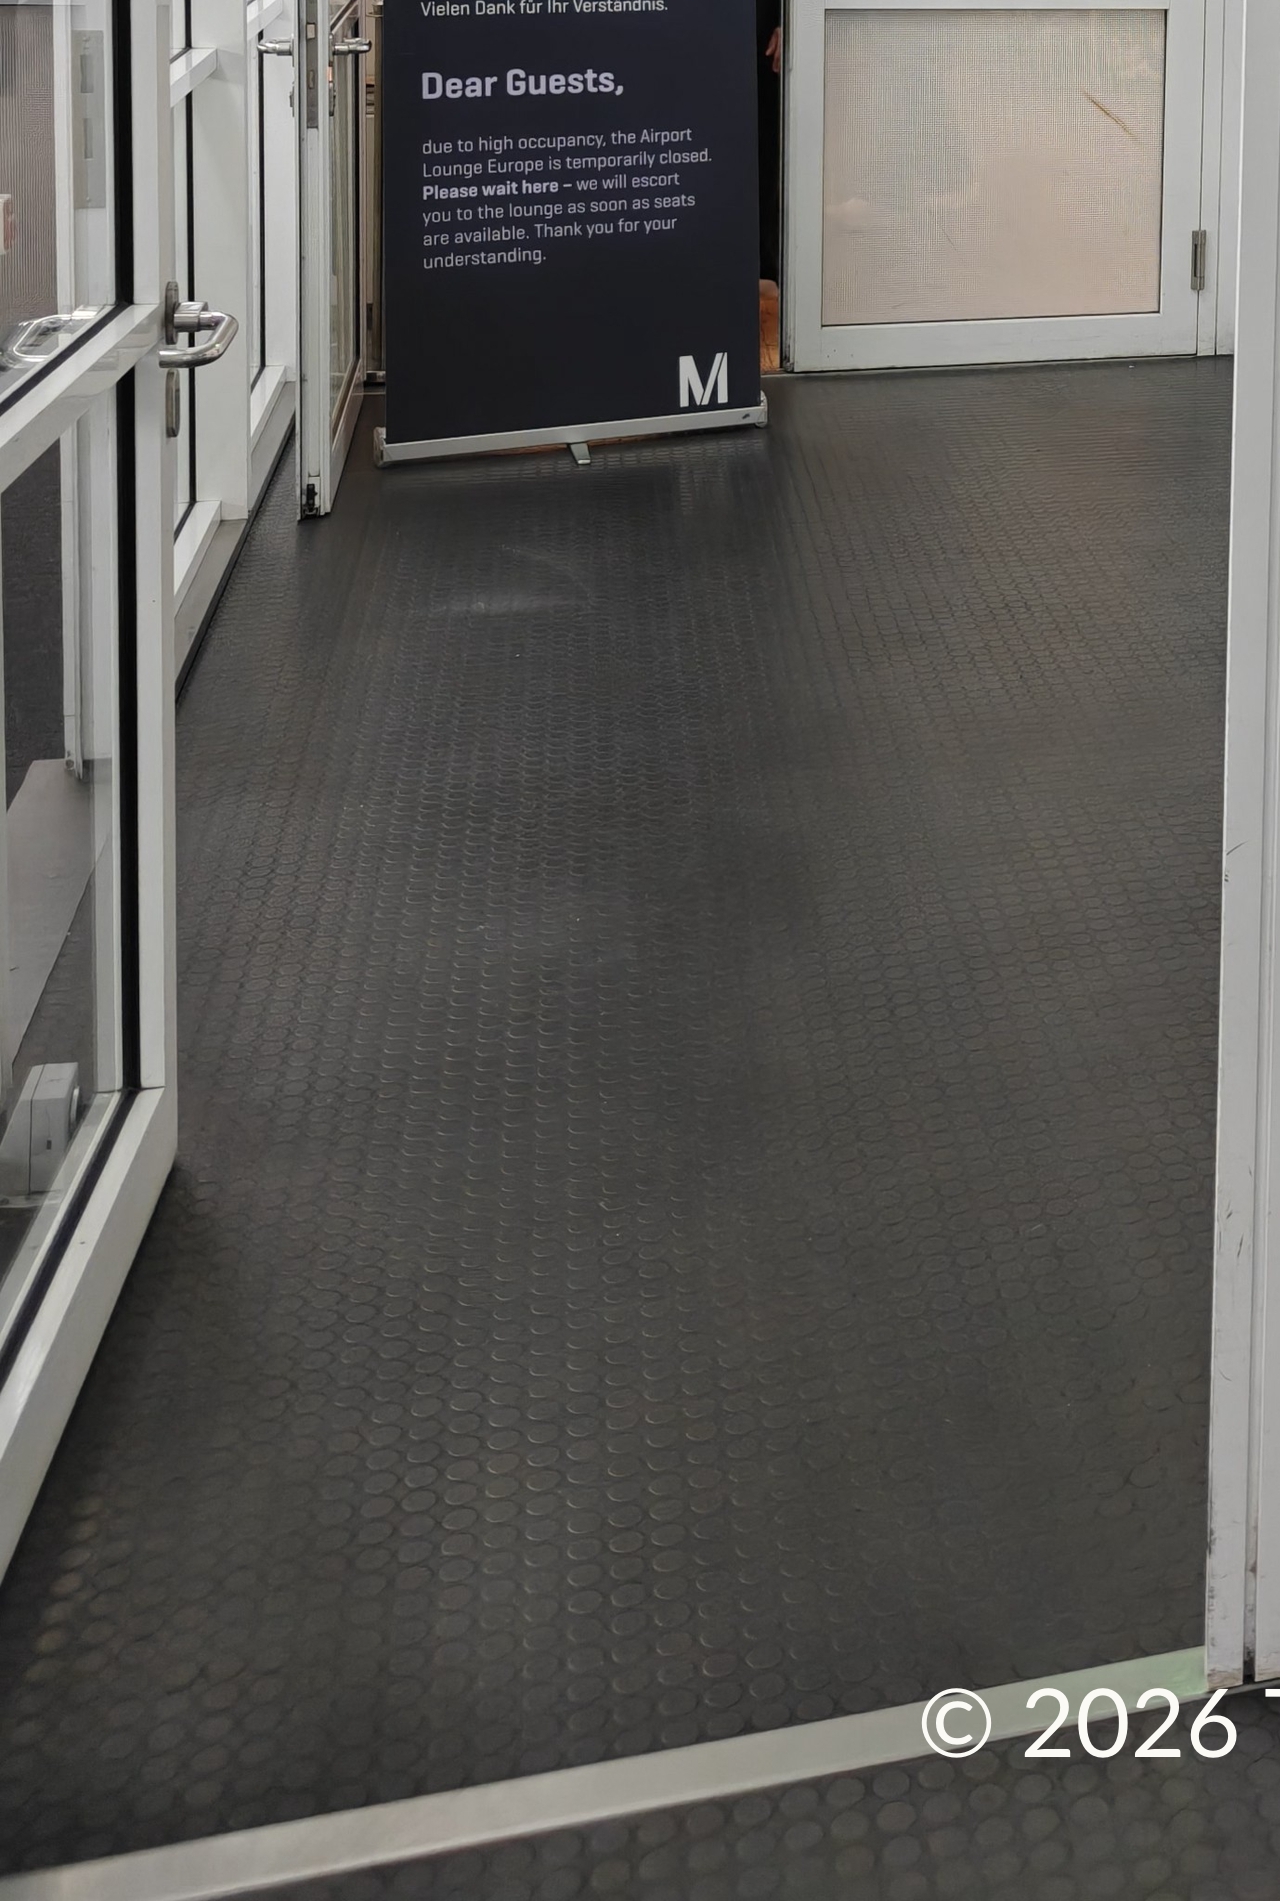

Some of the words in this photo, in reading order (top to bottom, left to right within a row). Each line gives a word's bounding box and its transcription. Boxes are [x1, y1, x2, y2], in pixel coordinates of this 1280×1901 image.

[421, 1, 469, 16] Vielen
[476, 0, 515, 15] Dank
[520, 0, 542, 14] für
[548, 0, 569, 13] Ihr
[422, 73, 497, 99] Dear
[507, 69, 623, 95] Guests,
[423, 140, 452, 154] due
[458, 140, 473, 152] to
[479, 136, 513, 154] high
[519, 135, 606, 151] occupancy,
[611, 131, 636, 144] the
[640, 129, 692, 145] Airport
[424, 163, 482, 178] Lounge
[488, 159, 543, 175] Europe
[549, 156, 561, 170] is
[566, 151, 655, 171] temporarily
[660, 148, 711, 164] closed.
[423, 185, 477, 200] Please
[482, 181, 518, 196] wait
[522, 180, 558, 194] here
[577, 179, 597, 190] we
[602, 174, 626, 189] will
[632, 173, 679, 187] escort
[423, 211, 450, 226] you
[457, 208, 472, 220] to
[478, 205, 503, 219] the
[510, 203, 562, 219] lounge
[568, 203, 585, 213] as
[591, 200, 627, 212] soon
[633, 199, 649, 209] as
[654, 195, 695, 208] seats
[424, 234, 449, 246] are
[455, 226, 529, 243] available.
[534, 222, 582, 237] Thank
[587, 223, 613, 238] you
[618, 218, 639, 232] for
[644, 219, 677, 234] your
[424, 247, 546, 269] understanding.
[679, 352, 728, 407] M
